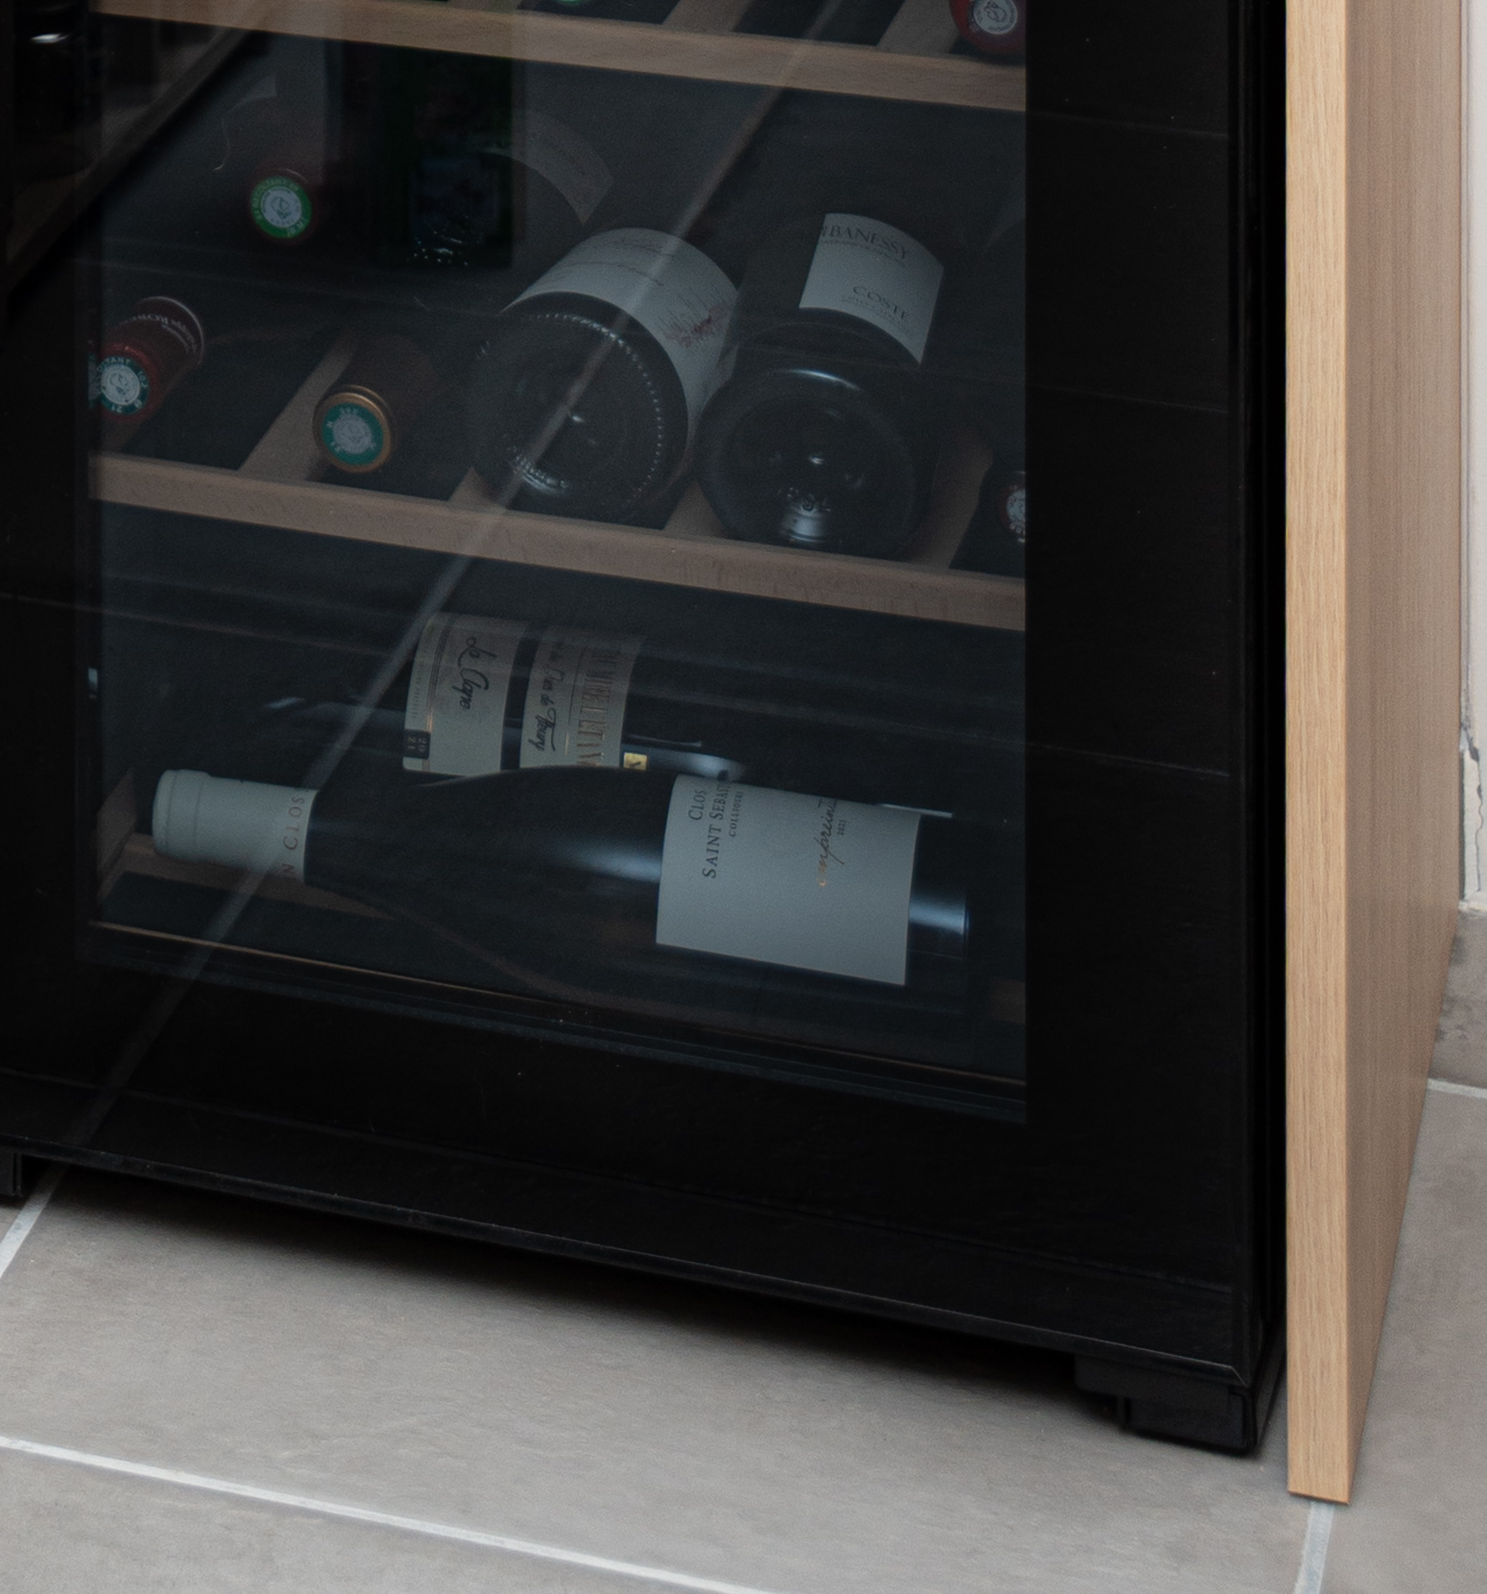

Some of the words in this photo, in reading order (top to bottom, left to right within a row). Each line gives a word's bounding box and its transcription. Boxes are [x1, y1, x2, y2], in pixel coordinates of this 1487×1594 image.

[282, 796, 305, 851] CLOS
[688, 788, 707, 822] CLOS
[701, 822, 723, 880] SAINT
